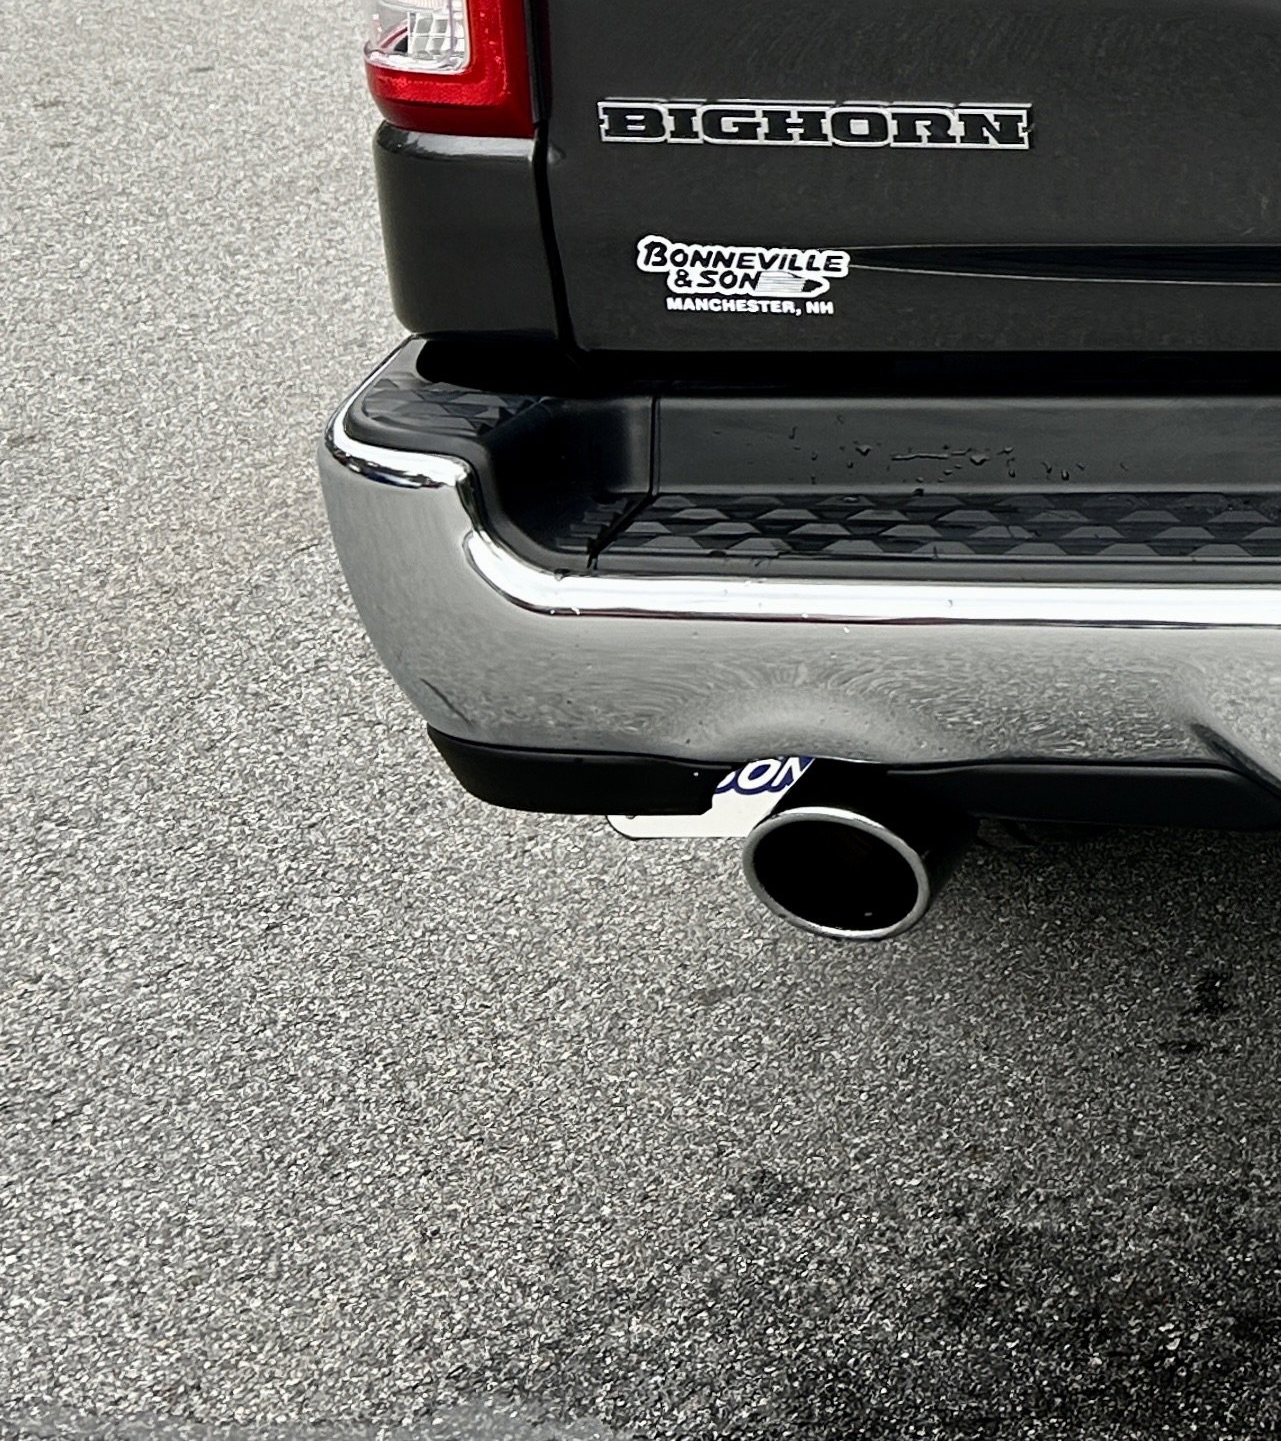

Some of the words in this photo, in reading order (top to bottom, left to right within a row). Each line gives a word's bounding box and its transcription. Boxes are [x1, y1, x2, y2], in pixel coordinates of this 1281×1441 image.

[597, 98, 1032, 150] BIGHORN
[642, 241, 844, 272] BONNEVILLE
[673, 269, 692, 289] &
[697, 270, 761, 292] SON
[666, 297, 801, 316] MANCHESTER,
[806, 301, 834, 315] NH
